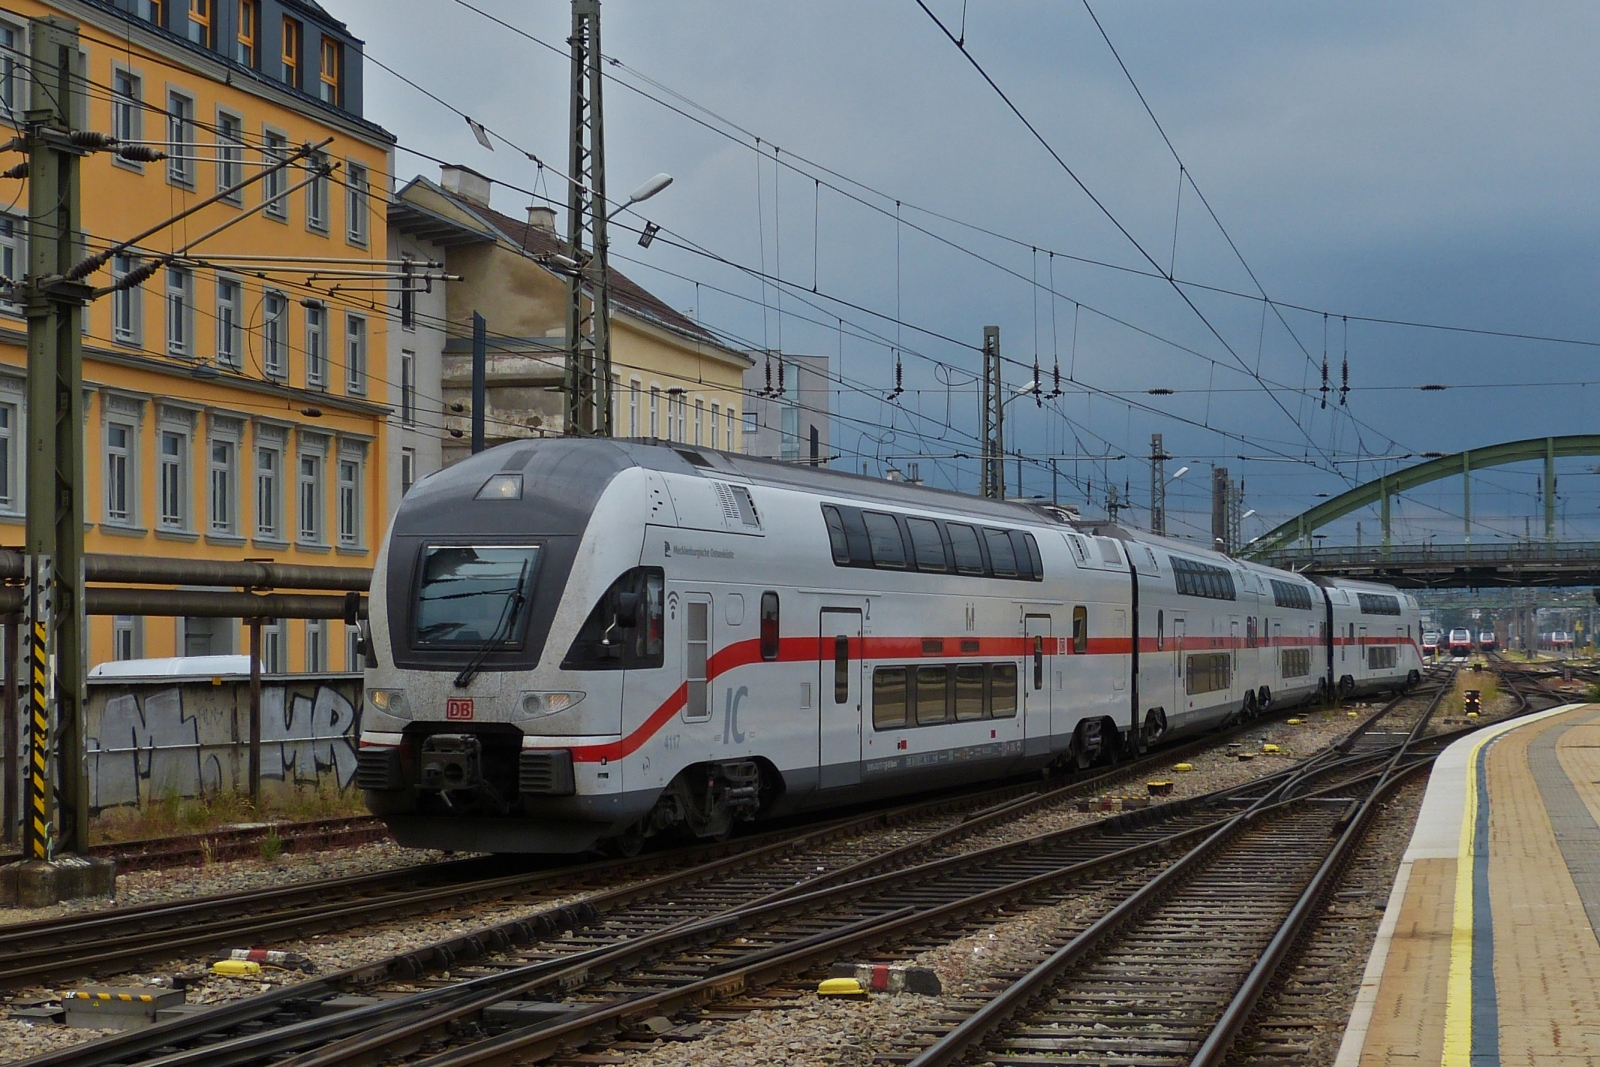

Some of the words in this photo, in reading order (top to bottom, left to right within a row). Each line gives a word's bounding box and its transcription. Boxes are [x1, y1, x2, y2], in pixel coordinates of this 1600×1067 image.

[865, 598, 871, 620] 2
[449, 702, 471, 717] DB
[723, 686, 748, 744] IC
[664, 735, 679, 750] 4117
